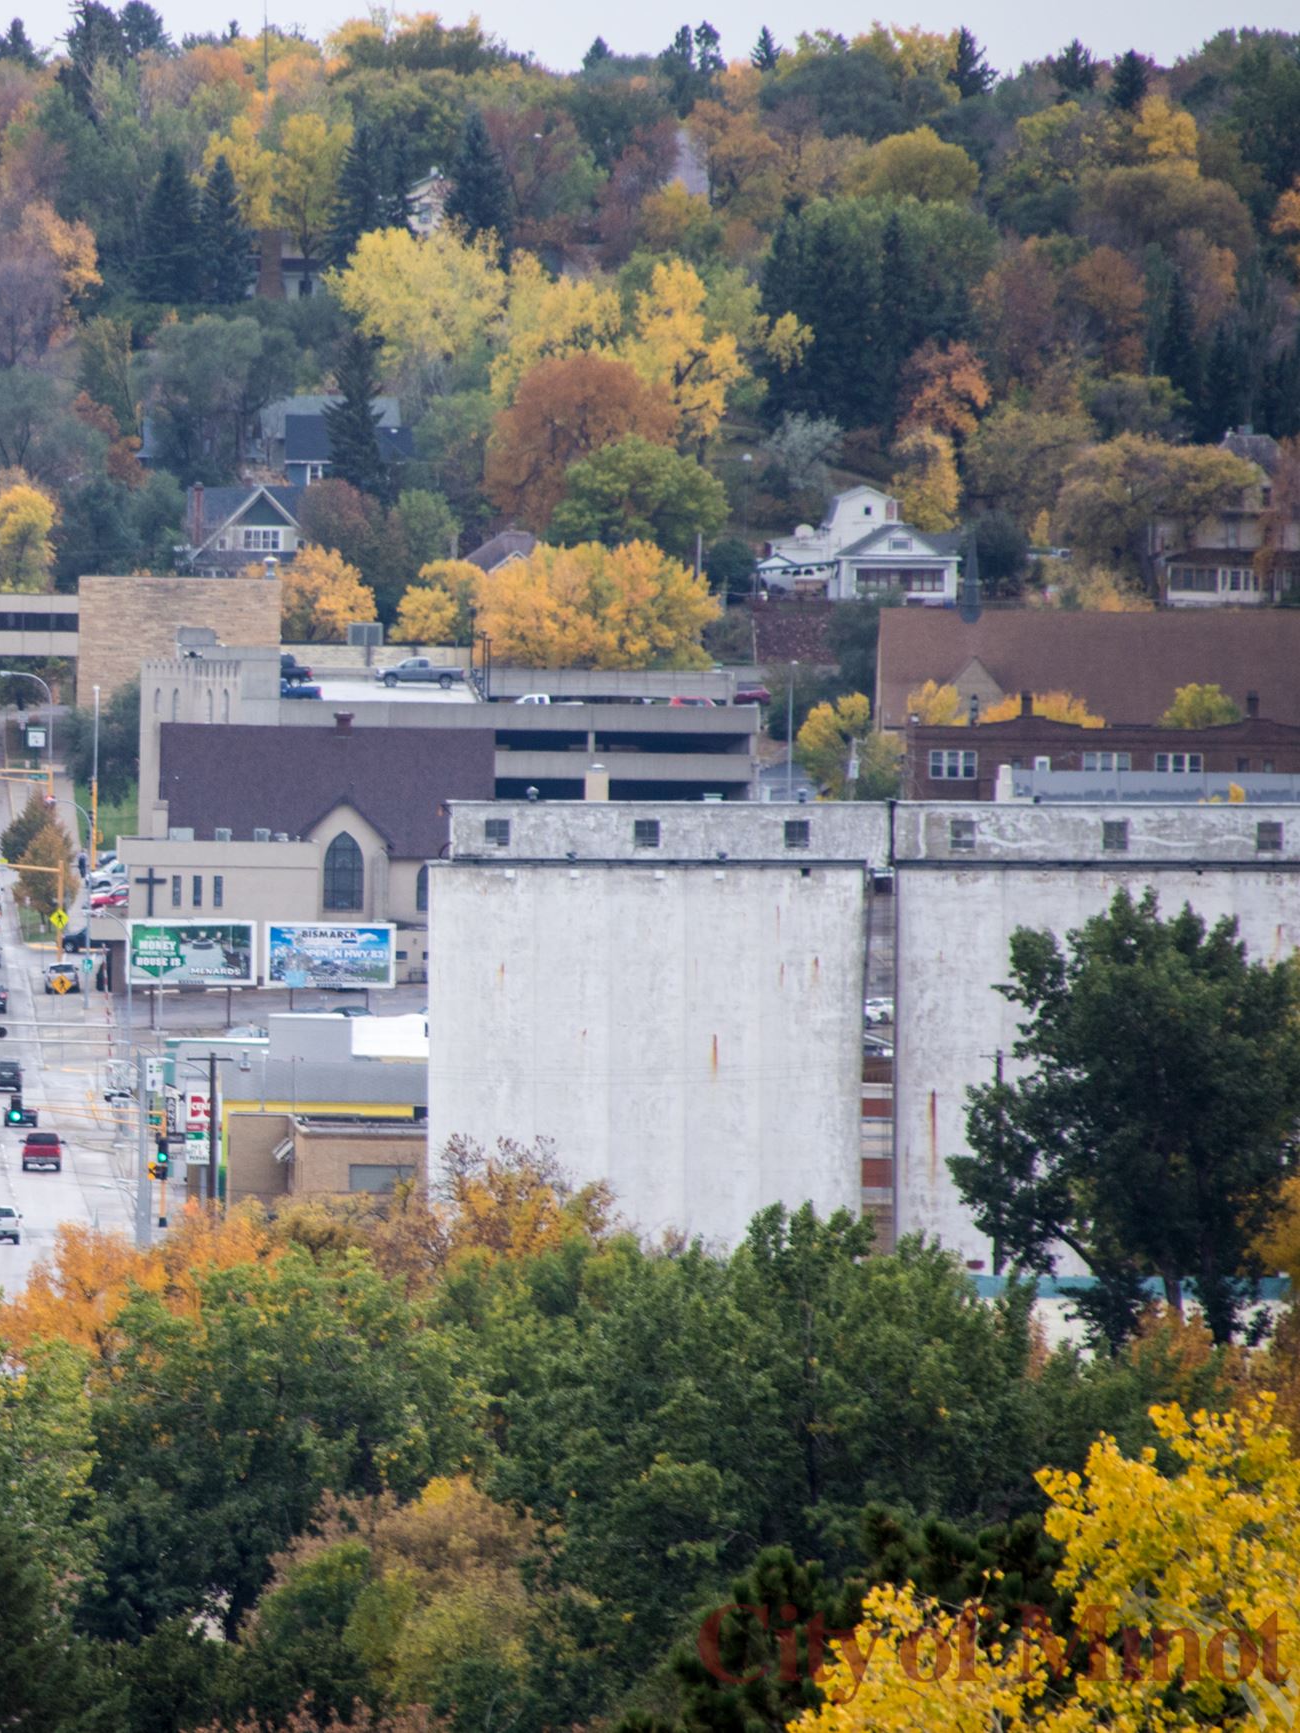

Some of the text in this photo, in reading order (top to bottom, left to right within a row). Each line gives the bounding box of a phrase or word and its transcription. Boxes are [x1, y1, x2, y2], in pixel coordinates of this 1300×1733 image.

[301, 929, 357, 939] BISMARCK
[138, 940, 176, 951] MONEY
[344, 949, 369, 959] HWY
[136, 957, 182, 967] HOUSE IS
[190, 967, 241, 976] MENARDS
